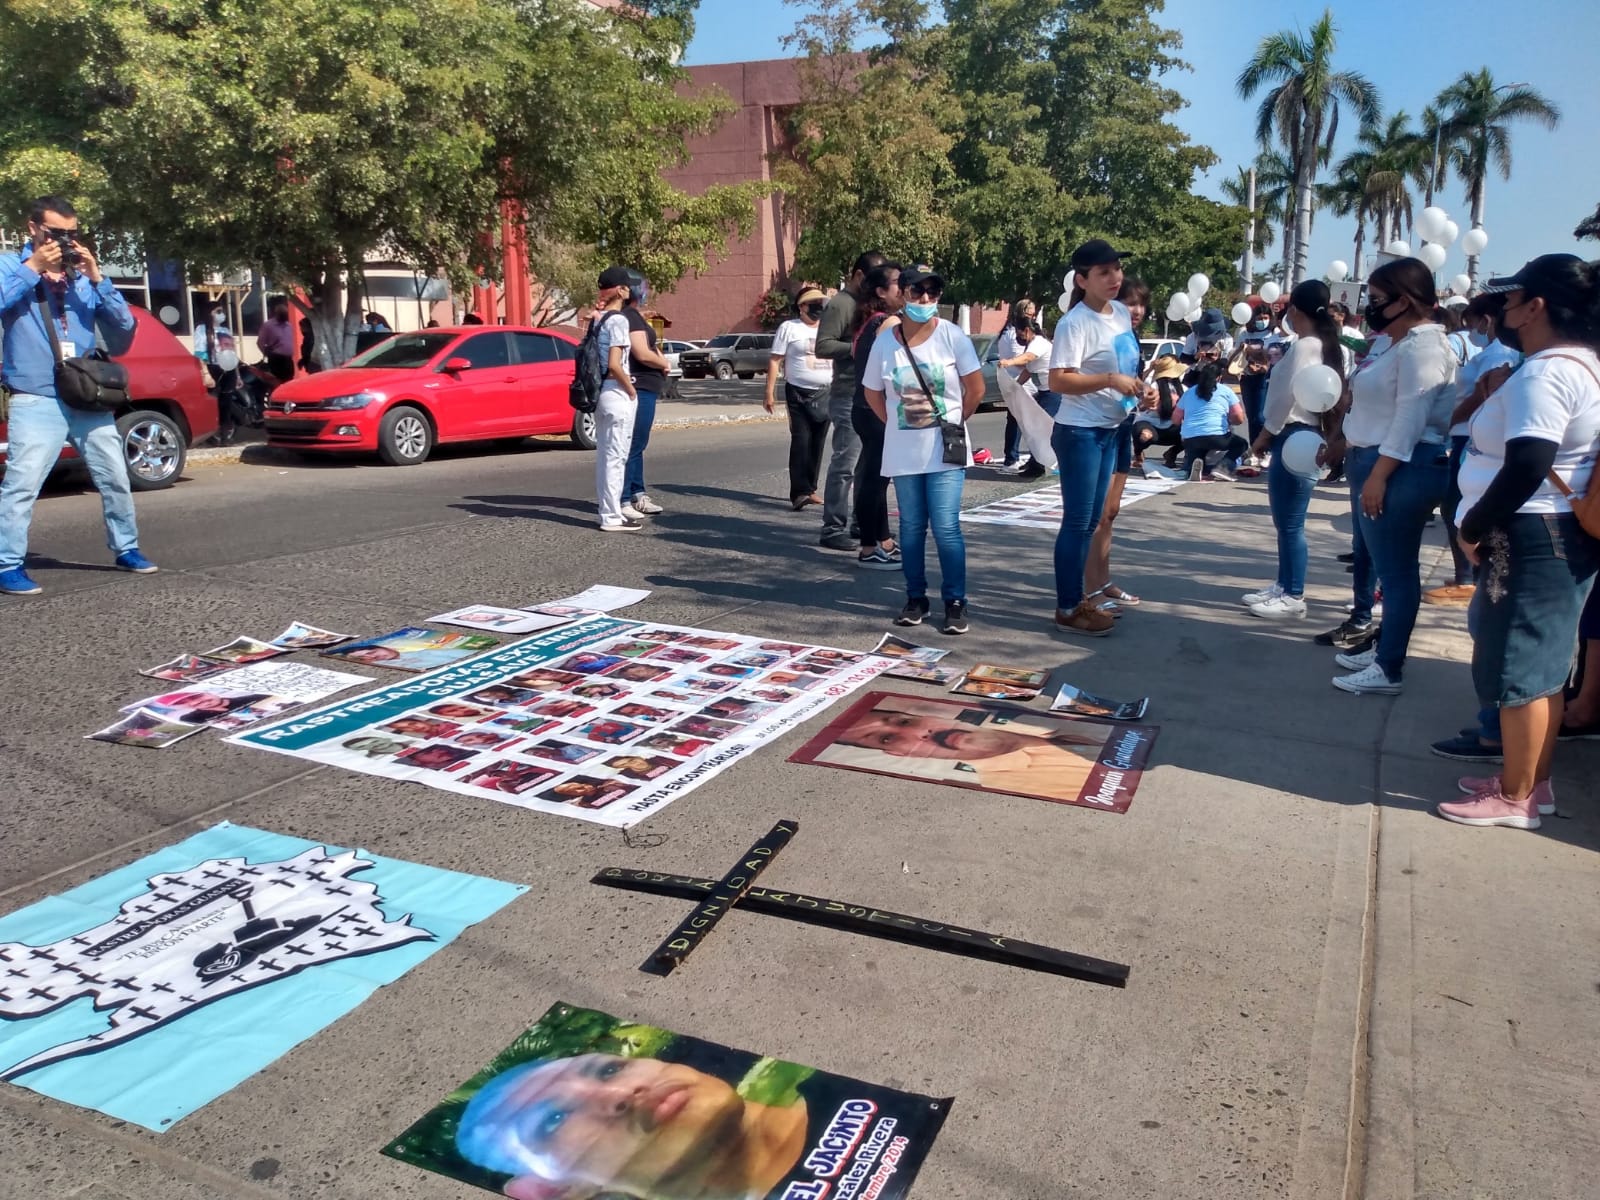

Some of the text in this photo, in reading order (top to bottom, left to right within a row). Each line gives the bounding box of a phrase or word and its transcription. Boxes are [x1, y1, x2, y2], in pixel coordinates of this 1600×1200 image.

[426, 654, 548, 697] GUASAVE
[824, 683, 849, 696] 687
[259, 661, 494, 741] RASTREADORAS
[627, 789, 673, 811] HASTA
[190, 879, 245, 907] GUASAVE
[668, 825, 793, 951] DIGNIDAD Y
[750, 889, 1008, 948] LA JUSTICIA
[858, 1117, 897, 1164] Rivera
